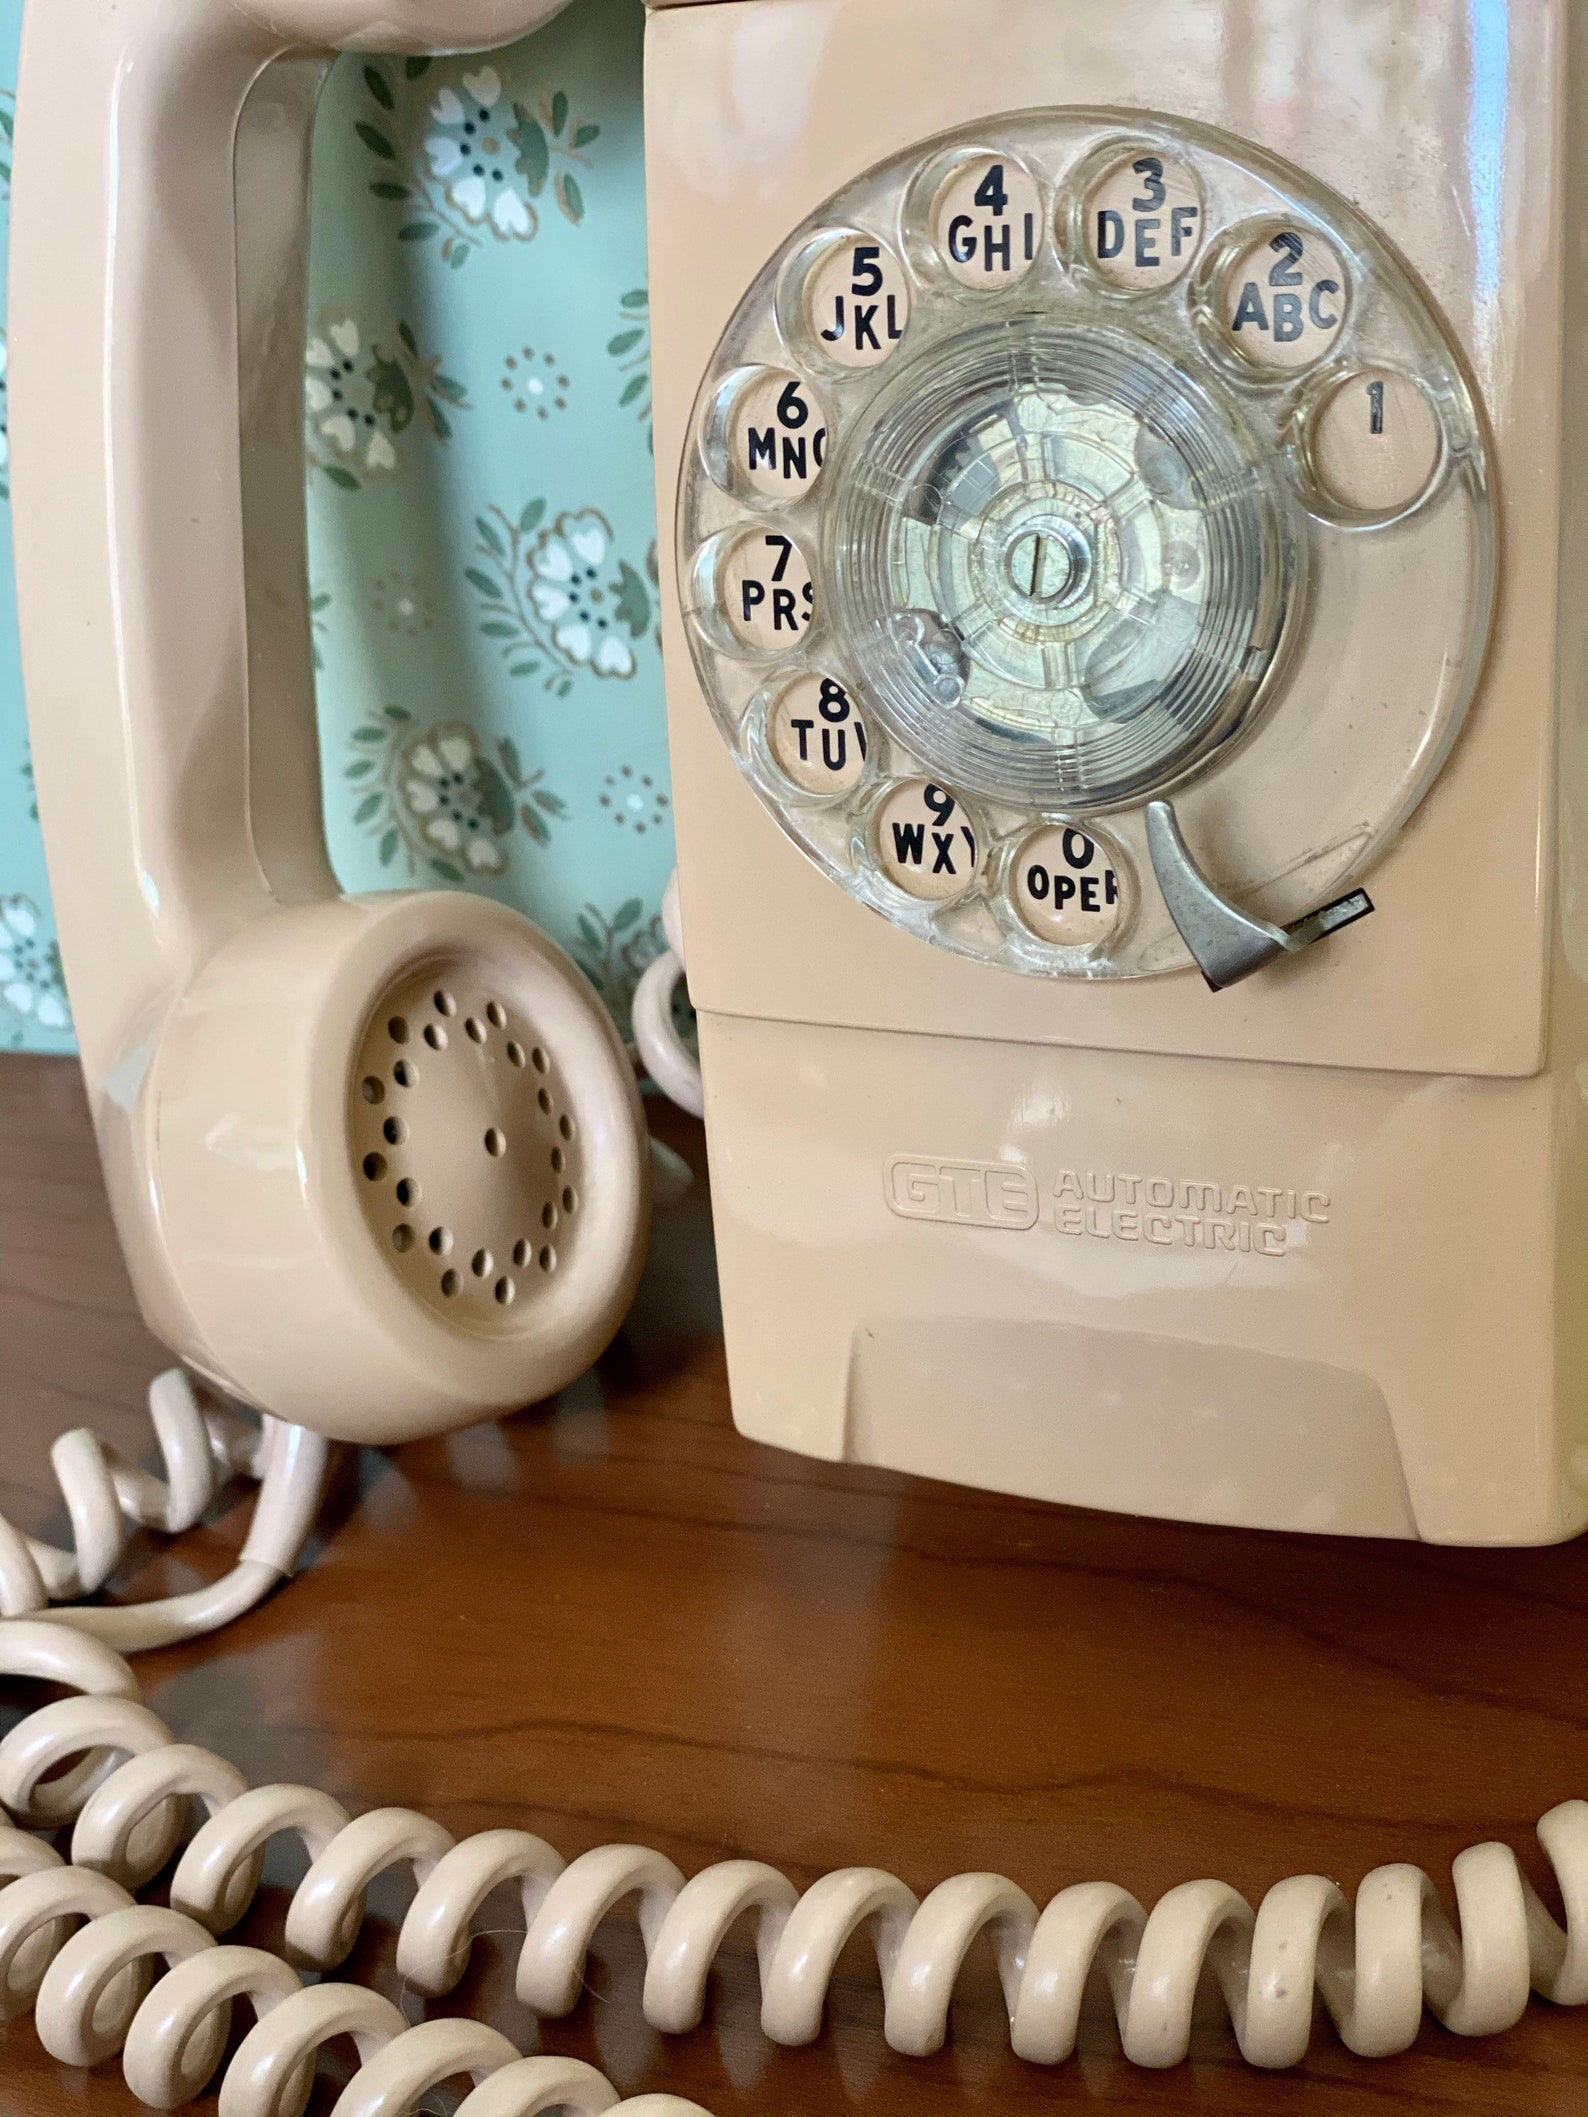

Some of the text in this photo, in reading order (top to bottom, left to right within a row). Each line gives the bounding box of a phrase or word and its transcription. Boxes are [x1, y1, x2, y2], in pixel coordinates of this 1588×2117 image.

[974, 164, 1009, 216] 4
[1132, 157, 1167, 212] 3
[948, 212, 1034, 272] GHI
[1097, 206, 1198, 267] DEF
[1268, 232, 1303, 287] 2
[851, 246, 883, 297] 5
[820, 294, 903, 350] JKL
[1231, 279, 1340, 342] ABC
[776, 381, 809, 429] 6
[1366, 381, 1384, 434] 1
[765, 535, 792, 581] 7
[818, 678, 850, 722] 8
[923, 783, 955, 826] 9
[891, 1161, 1030, 1221] GTE
[1053, 1169, 1331, 1224] AUTOMATIC
[1053, 1202, 1287, 1257] ELECTRIC
